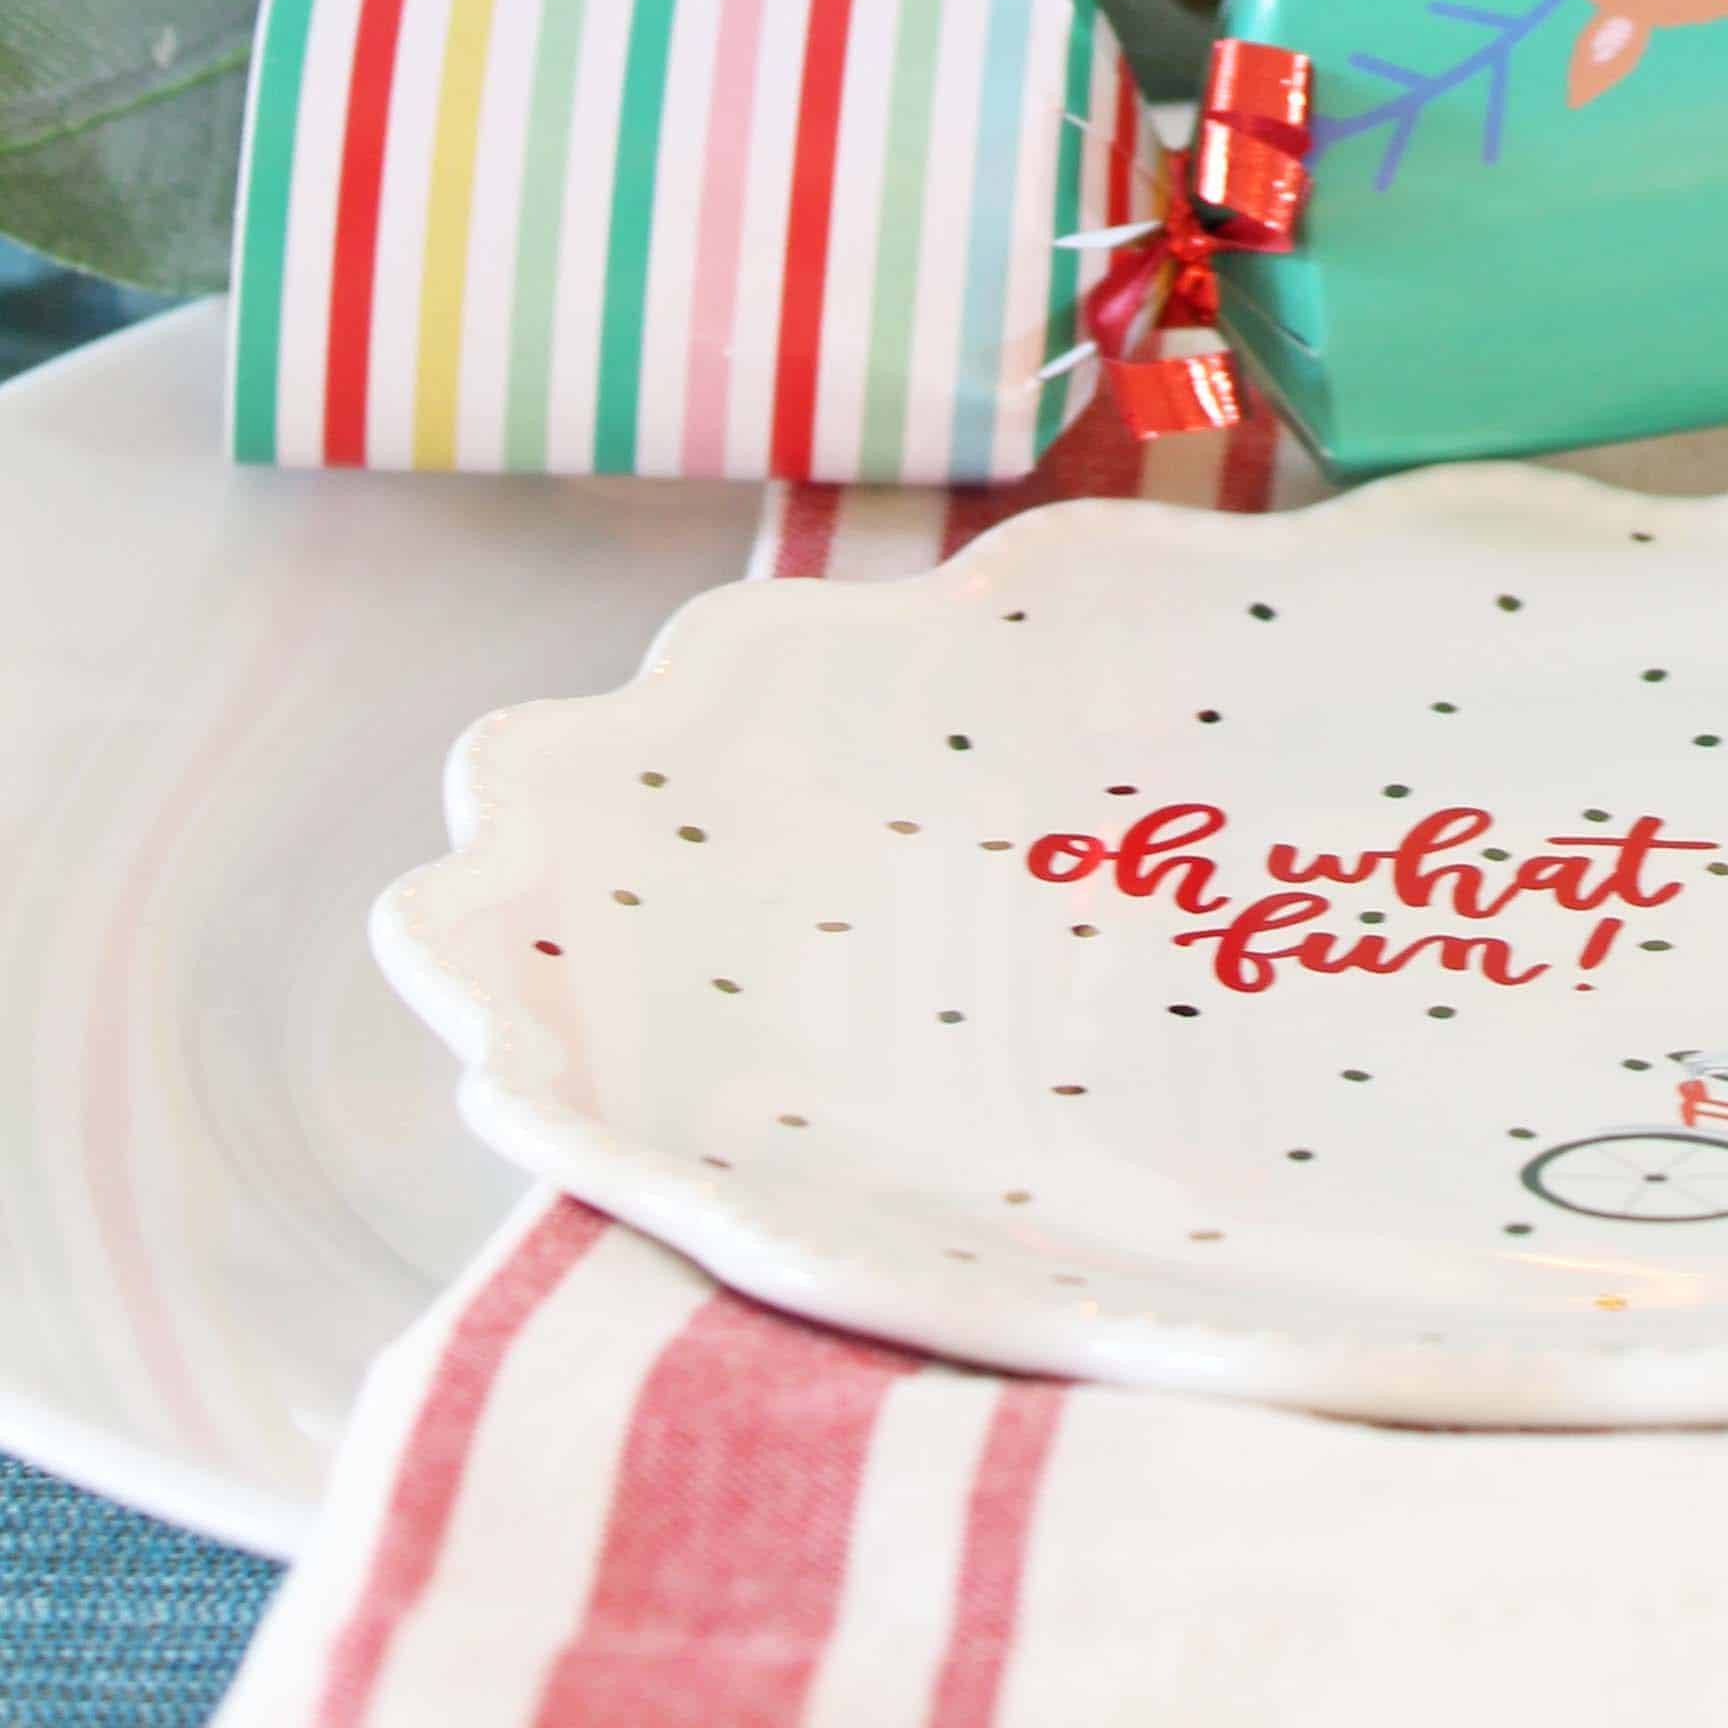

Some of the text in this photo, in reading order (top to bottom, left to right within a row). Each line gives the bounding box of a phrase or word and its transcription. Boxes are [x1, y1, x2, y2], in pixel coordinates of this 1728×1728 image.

[1025, 803, 1720, 920] oh what
[1172, 891, 1623, 994] fun!
